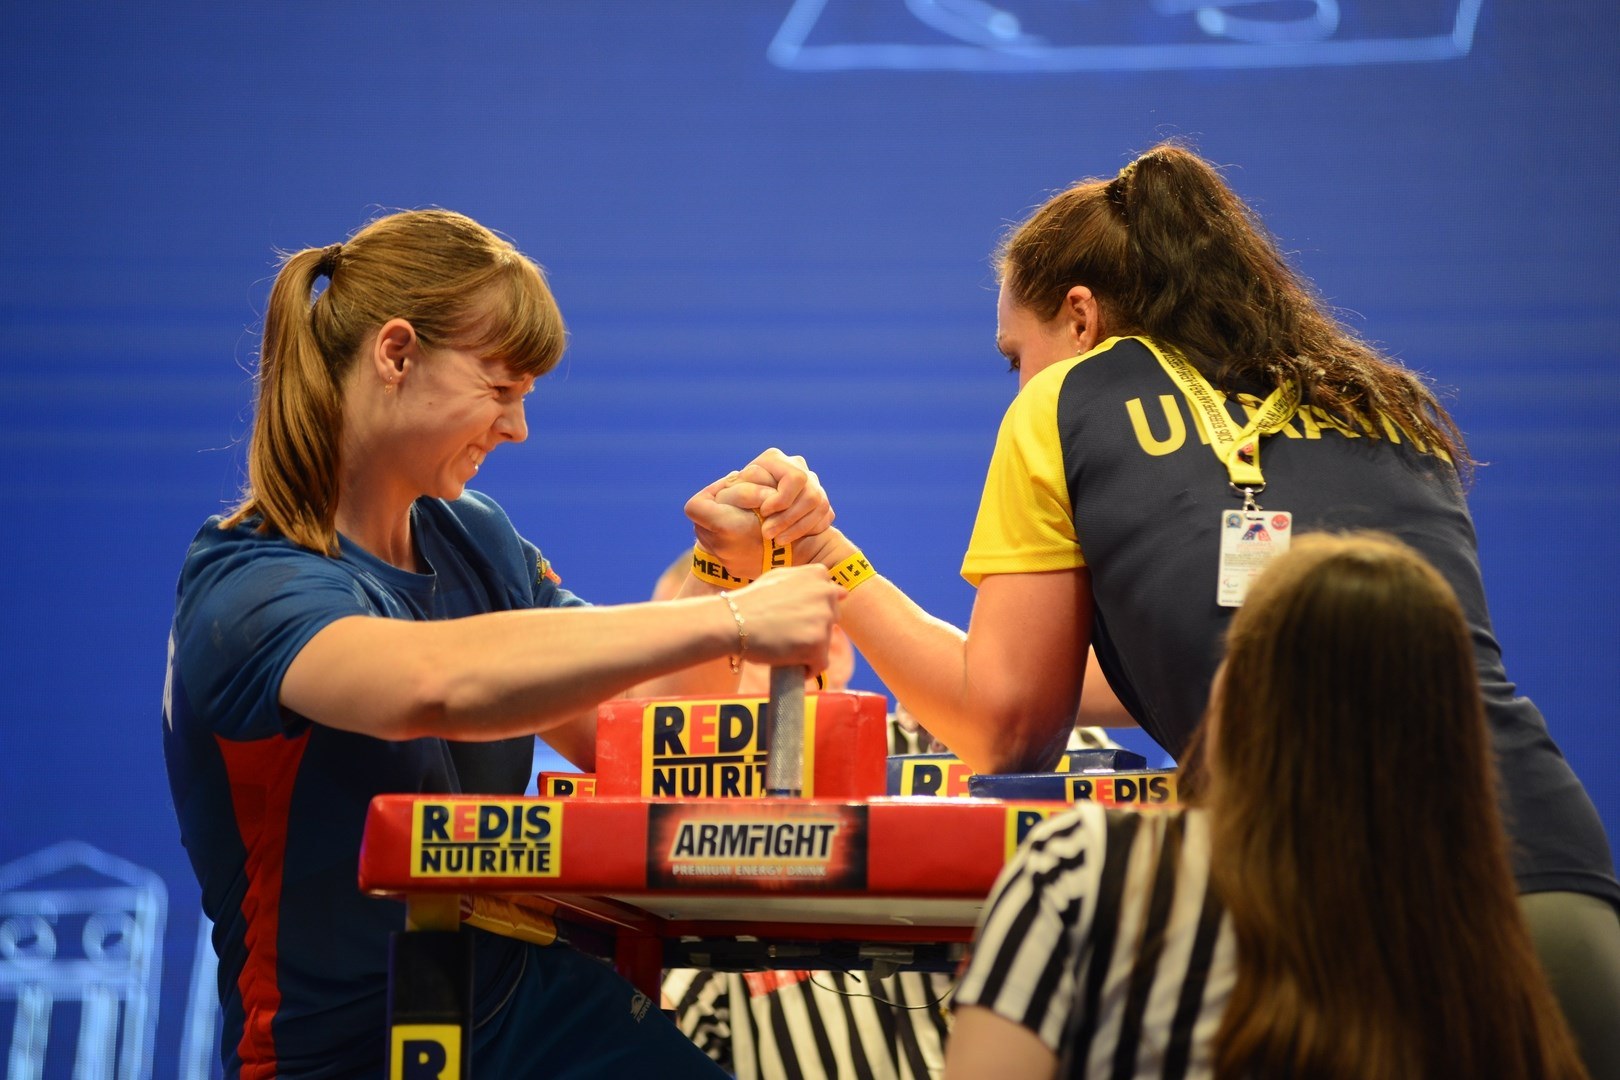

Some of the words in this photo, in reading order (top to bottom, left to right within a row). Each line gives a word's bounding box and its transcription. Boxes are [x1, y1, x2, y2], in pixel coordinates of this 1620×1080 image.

[653, 703, 767, 755] REDI
[652, 763, 767, 797] NUTRIT
[1072, 776, 1169, 804] REDIS
[422, 805, 551, 841] REDIS
[673, 823, 835, 858] ARMFIGHT
[420, 845, 551, 873] NUTRITIE
[672, 864, 731, 877] PREMIUM
[735, 865, 783, 877] ENERGY
[787, 865, 827, 877] DRINK
